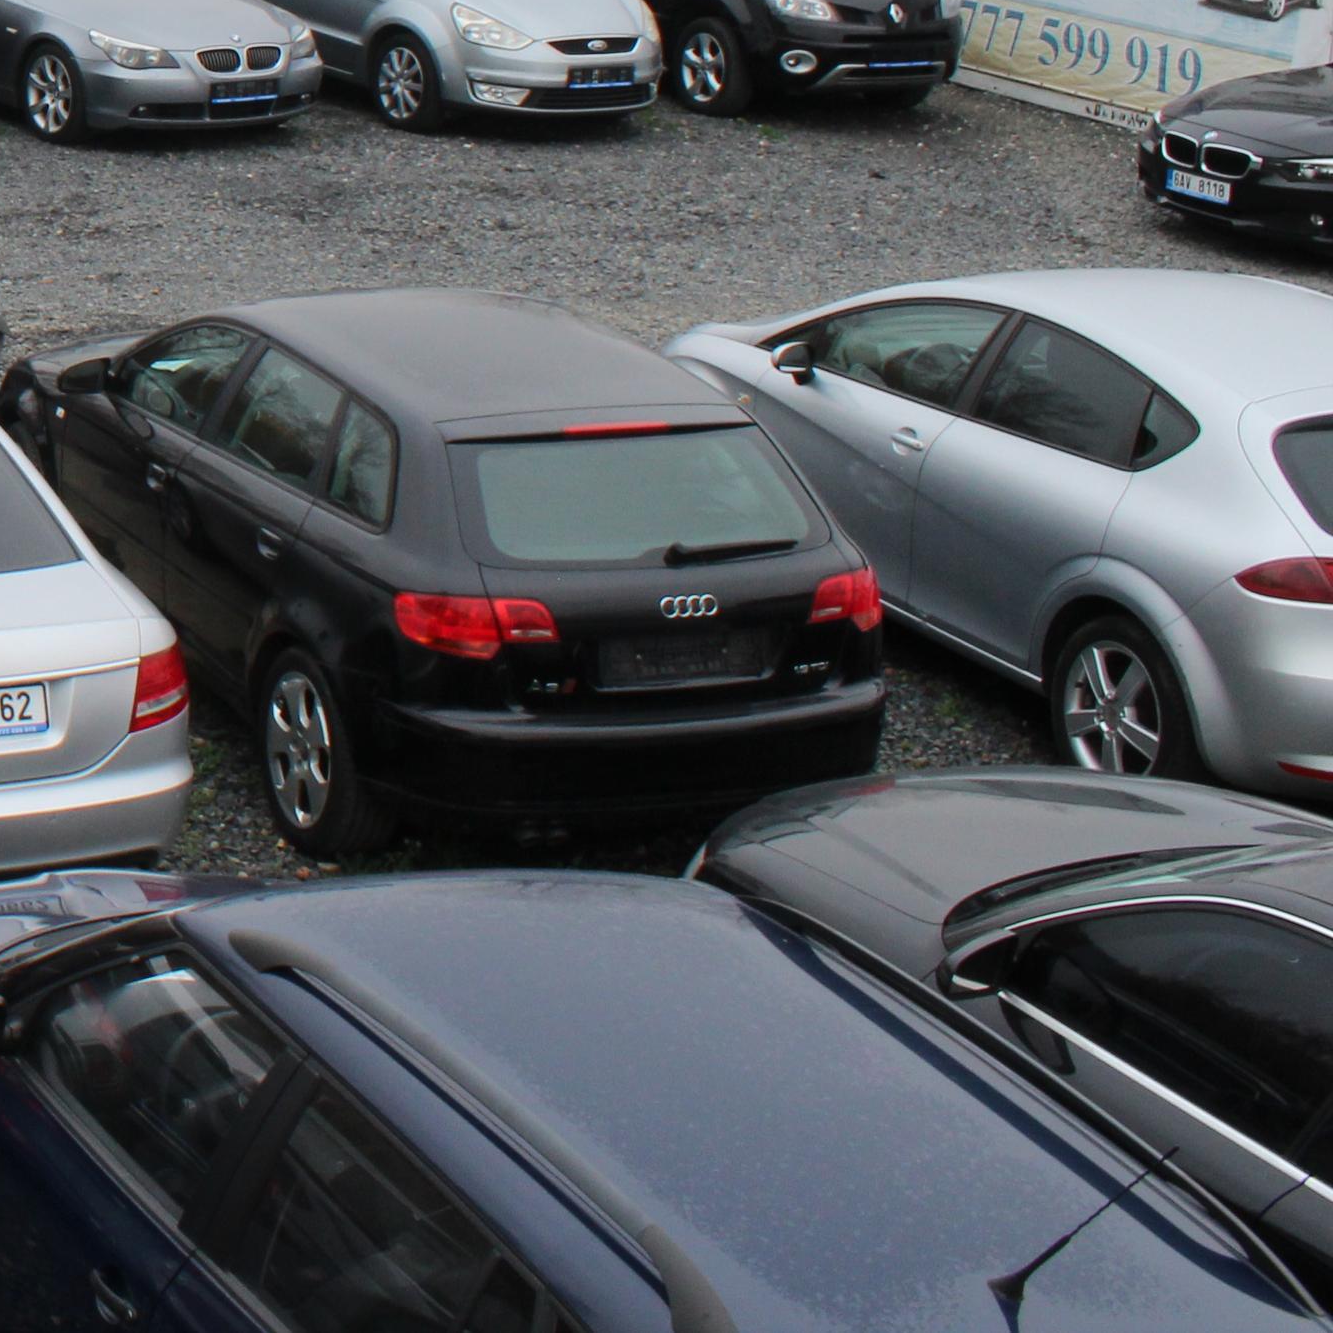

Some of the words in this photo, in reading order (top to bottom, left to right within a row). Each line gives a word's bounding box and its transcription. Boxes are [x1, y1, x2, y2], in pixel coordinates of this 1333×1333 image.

[960, 0, 1025, 58] 777
[1037, 18, 1110, 76] 599
[1125, 36, 1202, 97] 919
[1198, 179, 1225, 198] 8118
